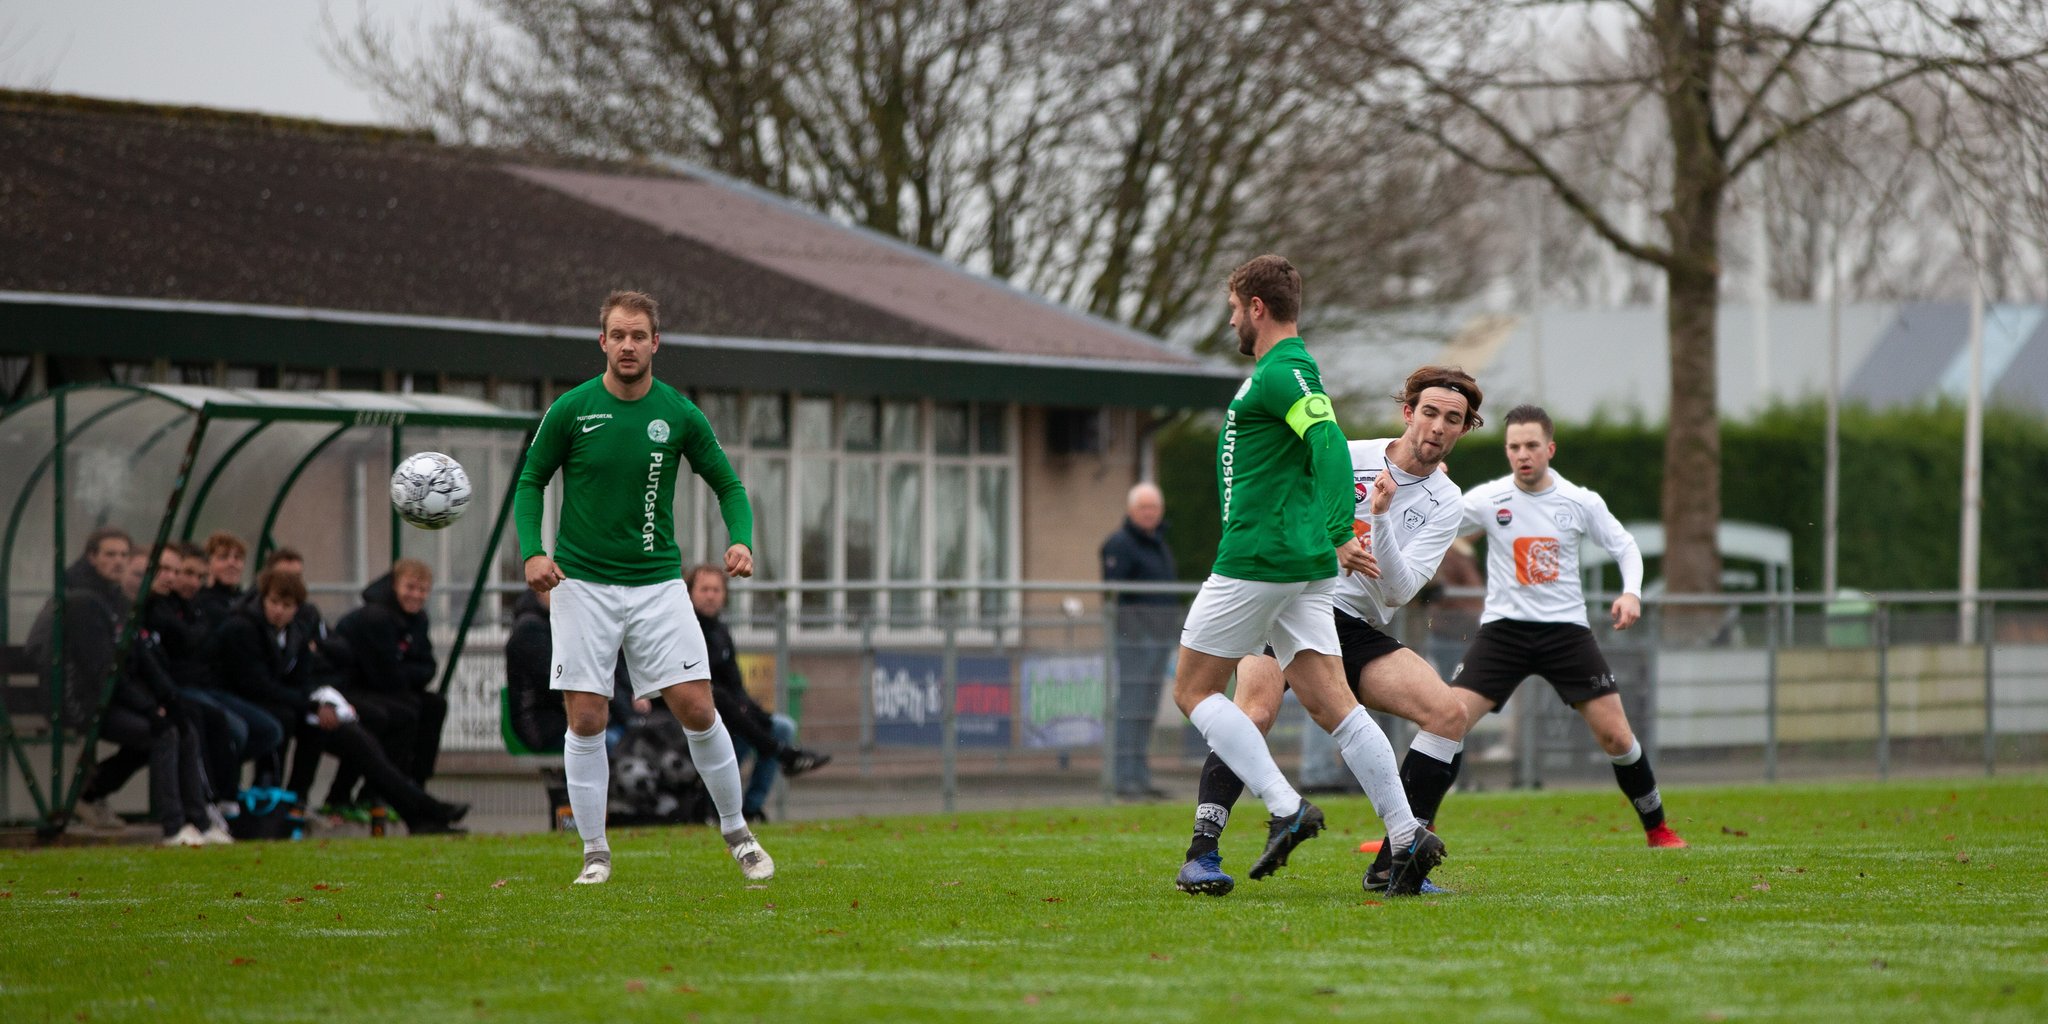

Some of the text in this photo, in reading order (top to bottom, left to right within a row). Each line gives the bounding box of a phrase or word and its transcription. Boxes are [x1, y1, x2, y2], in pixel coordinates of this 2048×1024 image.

[1304, 396, 1329, 418] C
[642, 452, 663, 553] PLUTOSPORT
[555, 664, 563, 679] 9
